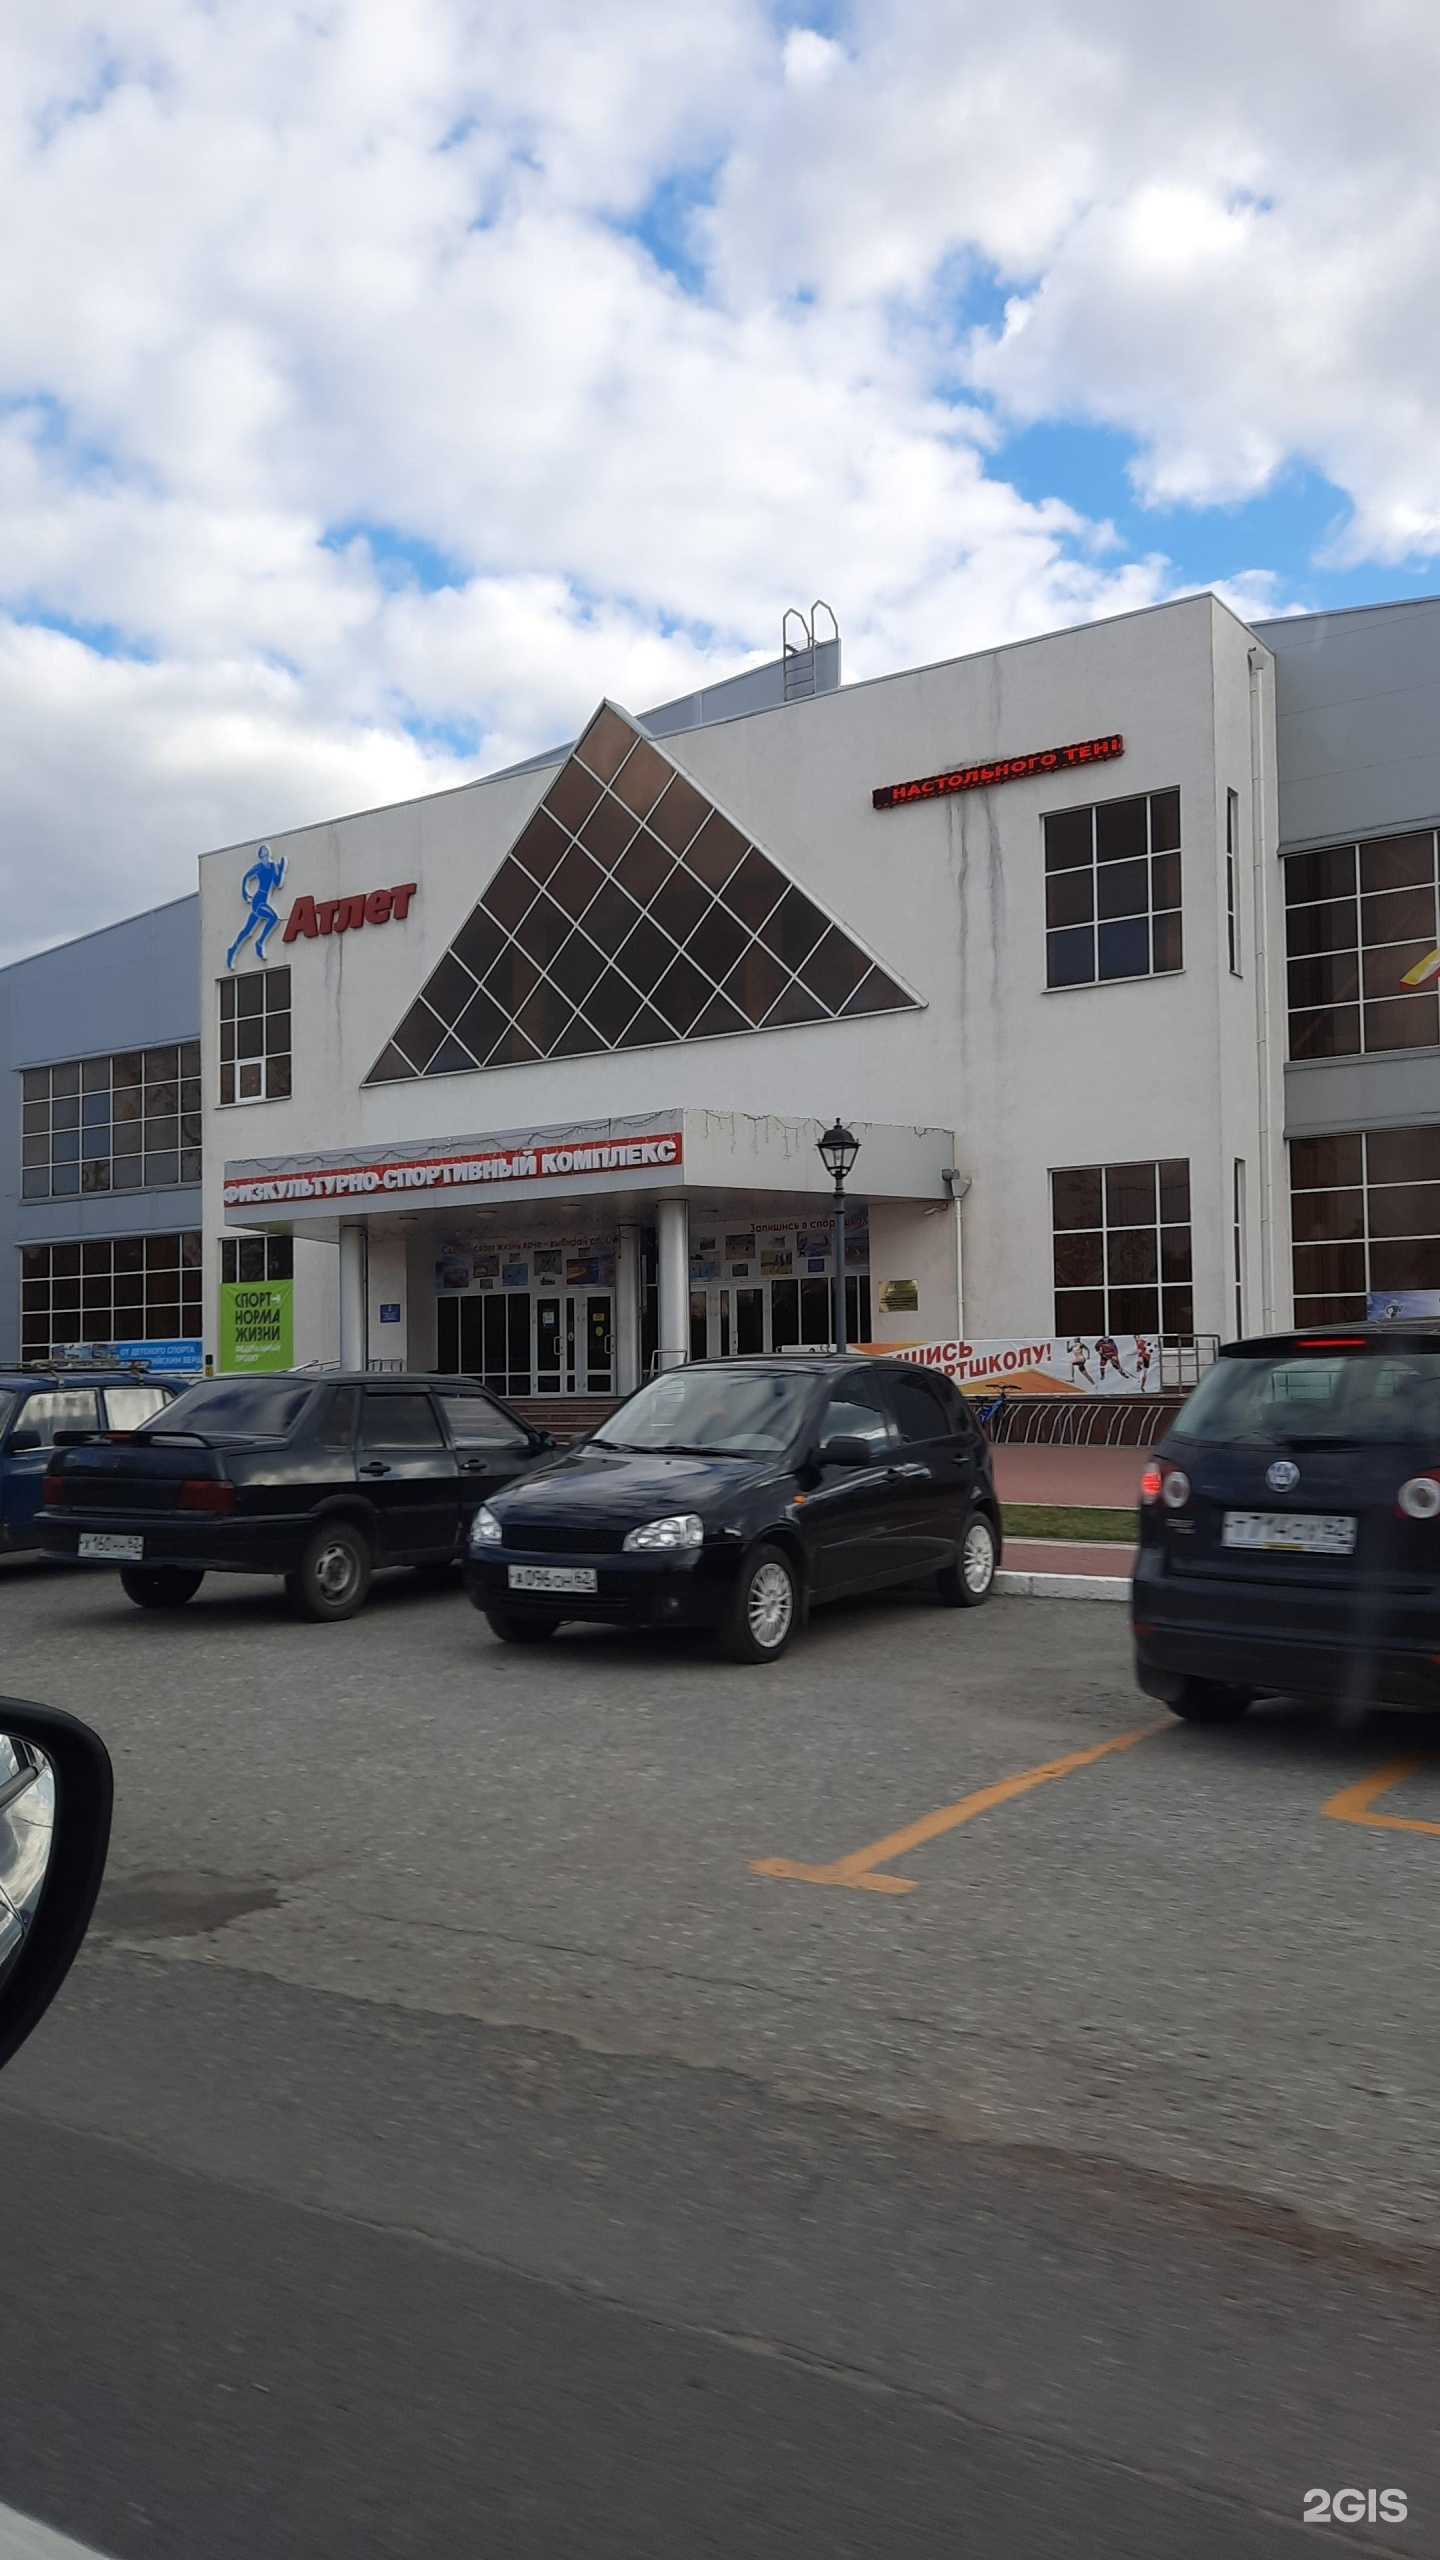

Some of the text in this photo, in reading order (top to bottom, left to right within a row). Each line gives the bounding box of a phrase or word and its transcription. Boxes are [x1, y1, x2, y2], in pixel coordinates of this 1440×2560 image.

[892, 754, 1057, 799] НАСТОЛЬНОГО
[224, 1140, 677, 1204] ФИЗКУЛЬТУРНО-СПОРТИВНЫЙ КОМПЛЕКС
[235, 1292, 272, 1308] СПОРТ
[235, 1309, 280, 1325] НОРМА
[235, 1326, 280, 1342] ЖИЗНИ
